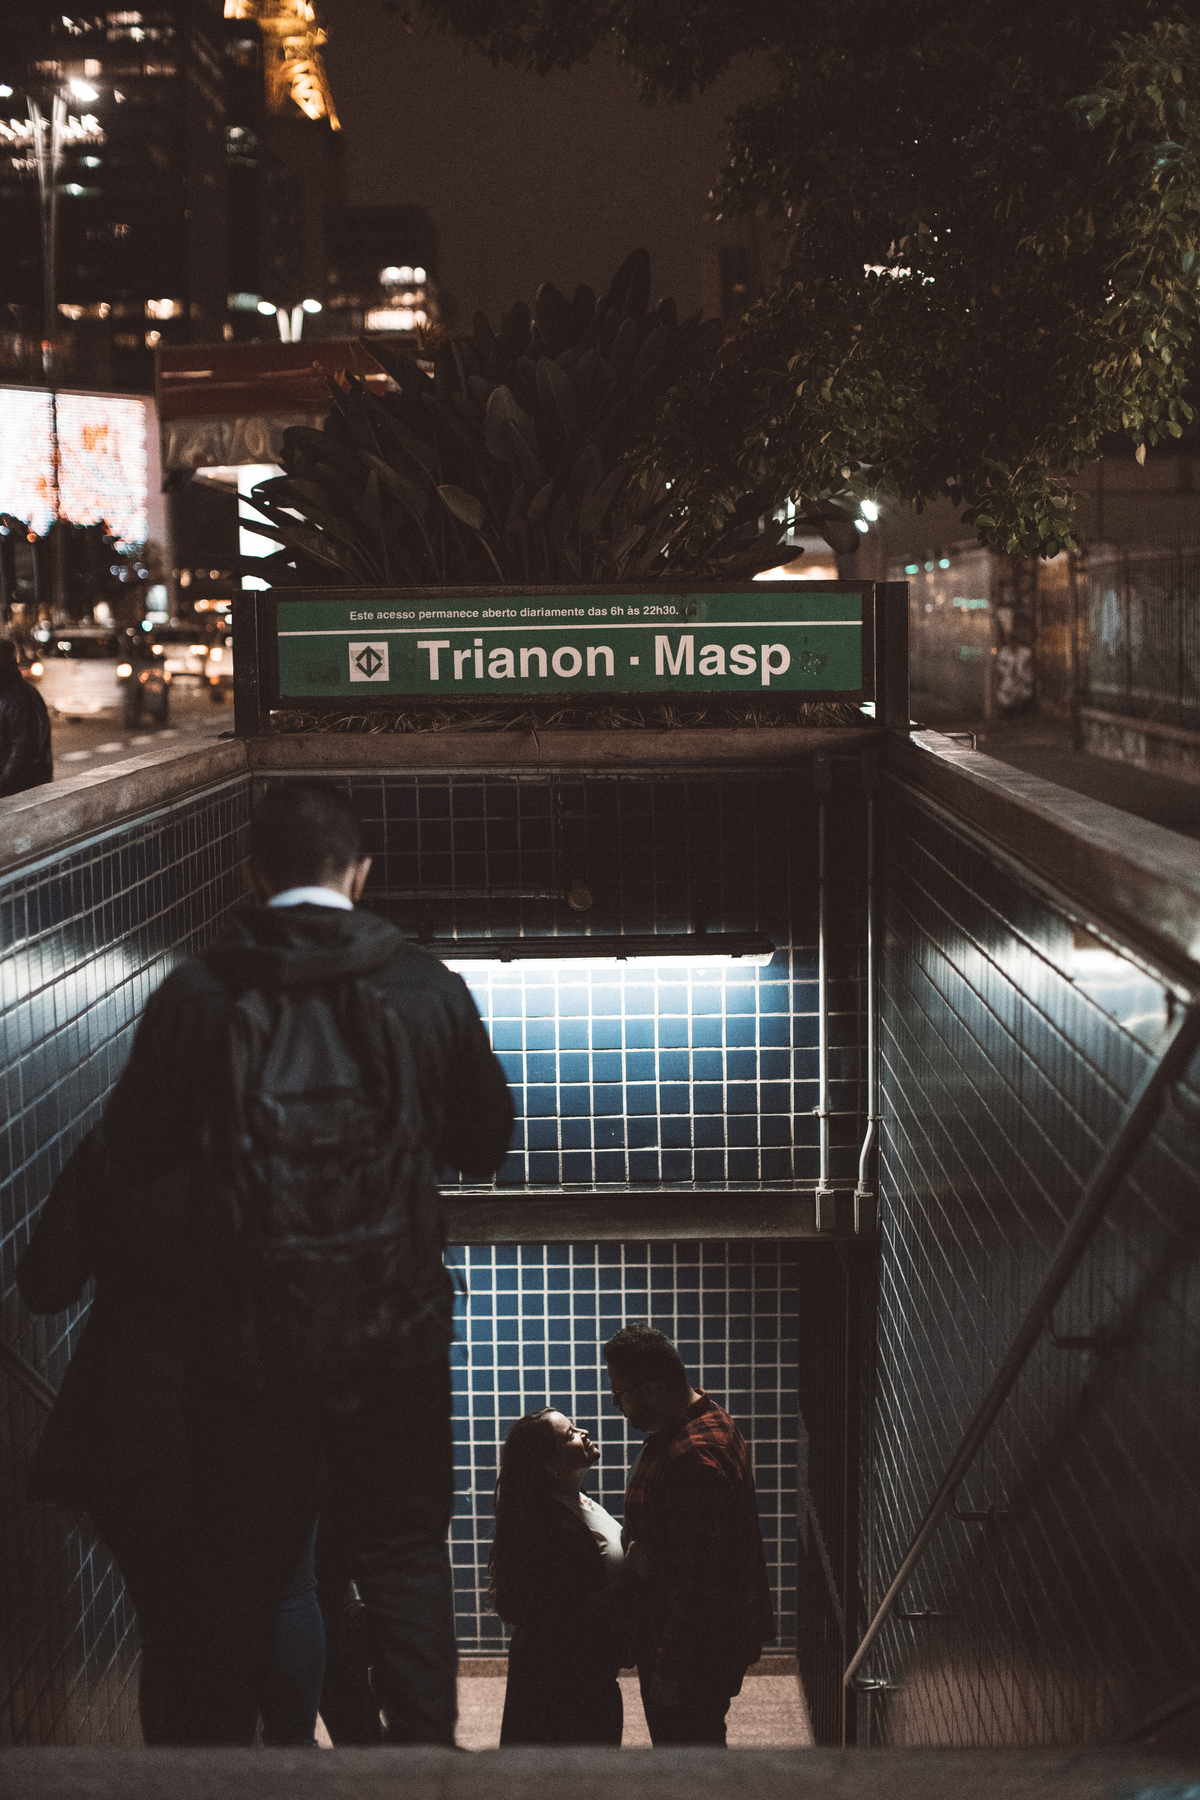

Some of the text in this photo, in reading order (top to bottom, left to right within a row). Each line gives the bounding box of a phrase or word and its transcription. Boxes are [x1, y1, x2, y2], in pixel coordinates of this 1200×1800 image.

[349, 605, 680, 621] Este acesso permanece aberto diariamente das 6h às 22h30.
[416, 638, 615, 681] Trianon
[654, 634, 791, 686] Masp
